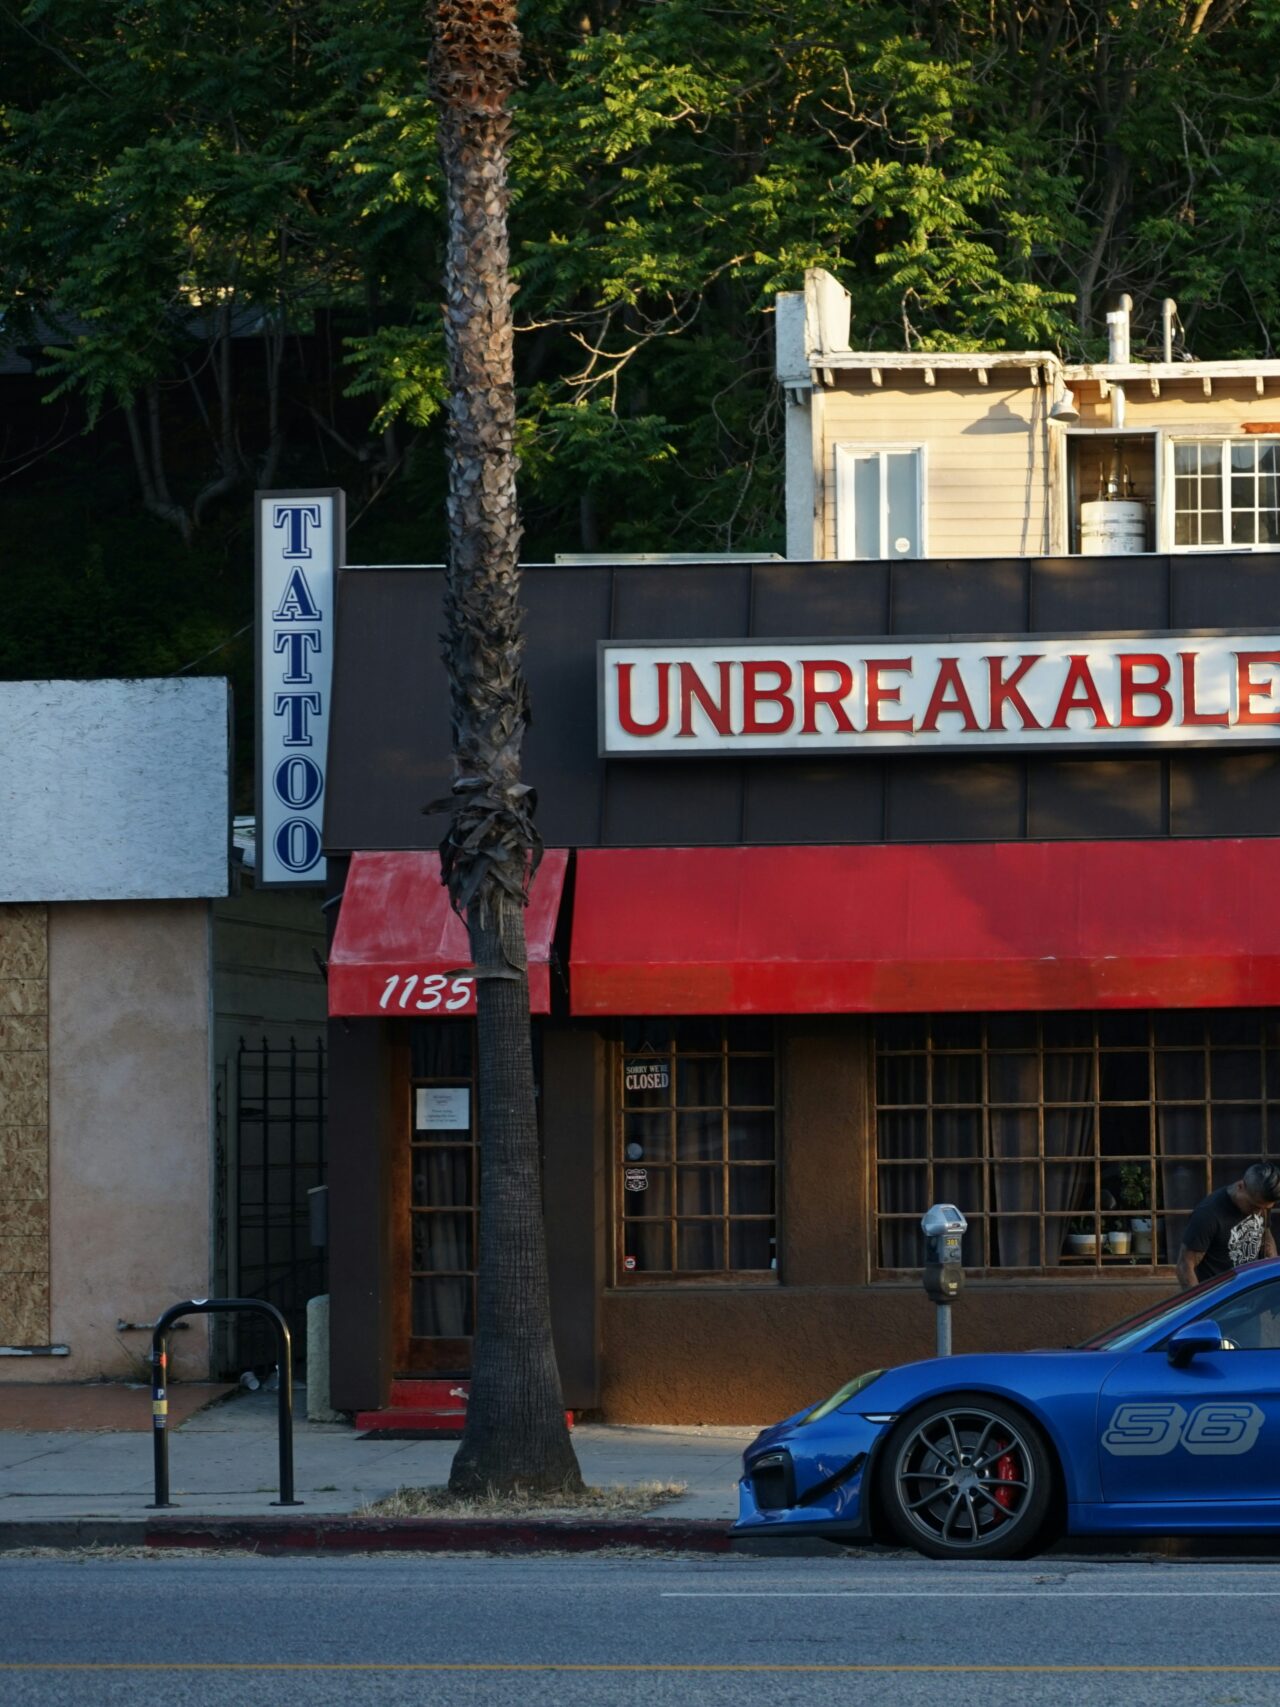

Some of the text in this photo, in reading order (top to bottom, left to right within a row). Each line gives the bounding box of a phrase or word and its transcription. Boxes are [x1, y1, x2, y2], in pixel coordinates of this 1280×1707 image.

[272, 504, 323, 874] TATTOO
[379, 974, 478, 1010] 1135
[626, 1065, 648, 1074] SORRY
[626, 1072, 669, 1090] CLOSED
[1101, 1402, 1266, 1456] 56
